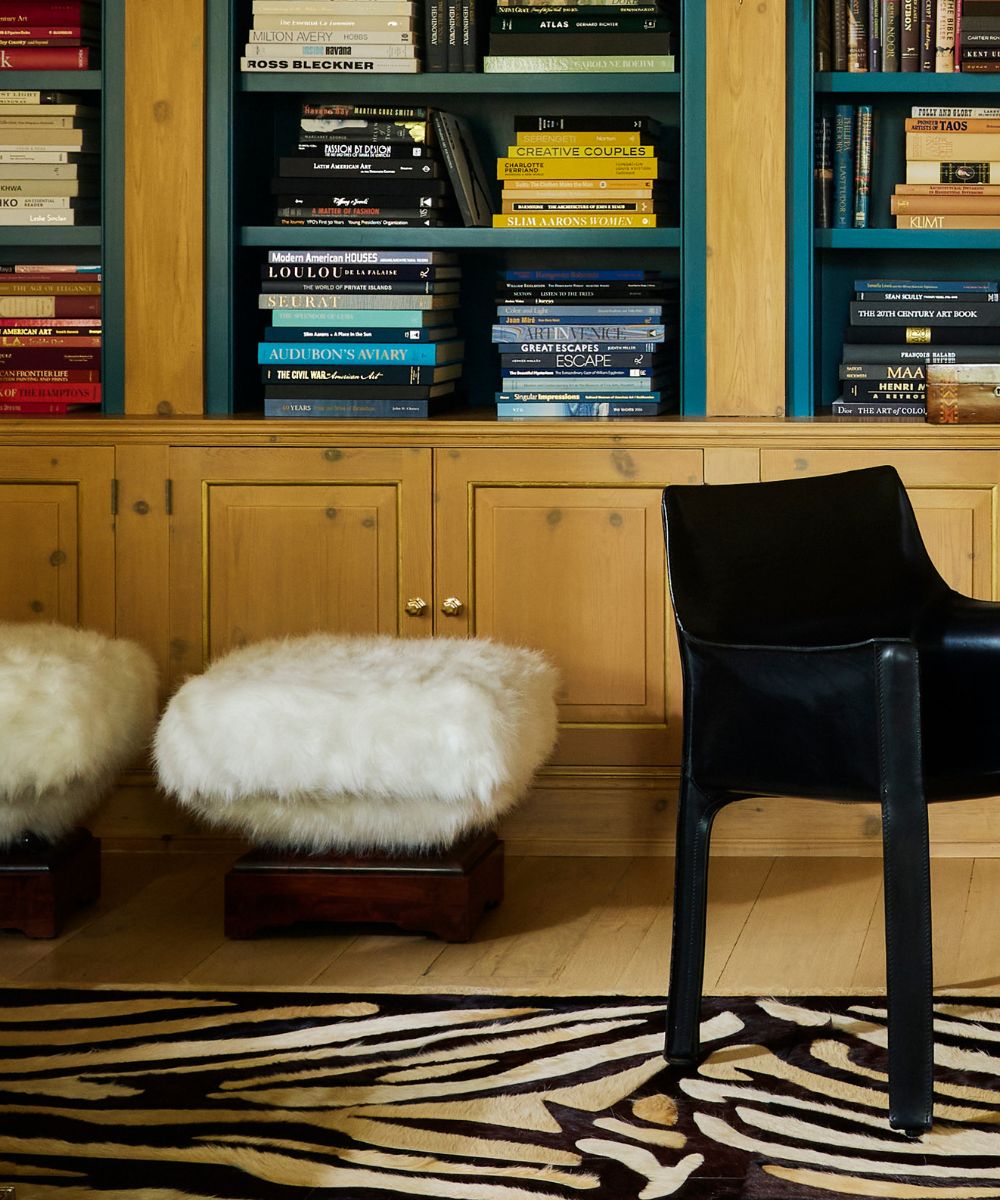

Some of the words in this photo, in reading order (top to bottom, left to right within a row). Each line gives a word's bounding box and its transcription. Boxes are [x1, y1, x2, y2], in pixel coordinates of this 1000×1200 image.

[253, 32, 293, 41] MILTON
[297, 32, 333, 41] AVERY
[248, 61, 288, 69] ROSS
[292, 61, 374, 69] BLECKNER
[918, 108, 937, 117] FOLLY
[939, 108, 951, 117] AND
[952, 108, 972, 117] GLORY
[940, 121, 968, 131] TAOS
[324, 144, 352, 154] PASSION
[354, 144, 363, 154] BY
[365, 144, 391, 154] DESIGN
[516, 148, 580, 156] CREATIVE
[584, 148, 646, 156] COUPLES
[507, 217, 537, 226] SLIM
[539, 217, 587, 226] AARONS
[590, 217, 633, 226] WOMEN
[910, 216, 944, 228] KLIMT
[272, 253, 304, 263] Modern
[305, 253, 343, 263] American
[344, 253, 378, 263] HOUSES
[268, 267, 343, 278] LOULOU
[267, 296, 340, 307] SEURAT
[357, 349, 408, 360] AVIARY
[556, 354, 611, 367] ESCAPE
[277, 370, 291, 379] THE
[291, 370, 308, 379] CIVIL
[310, 370, 326, 379] WAR
